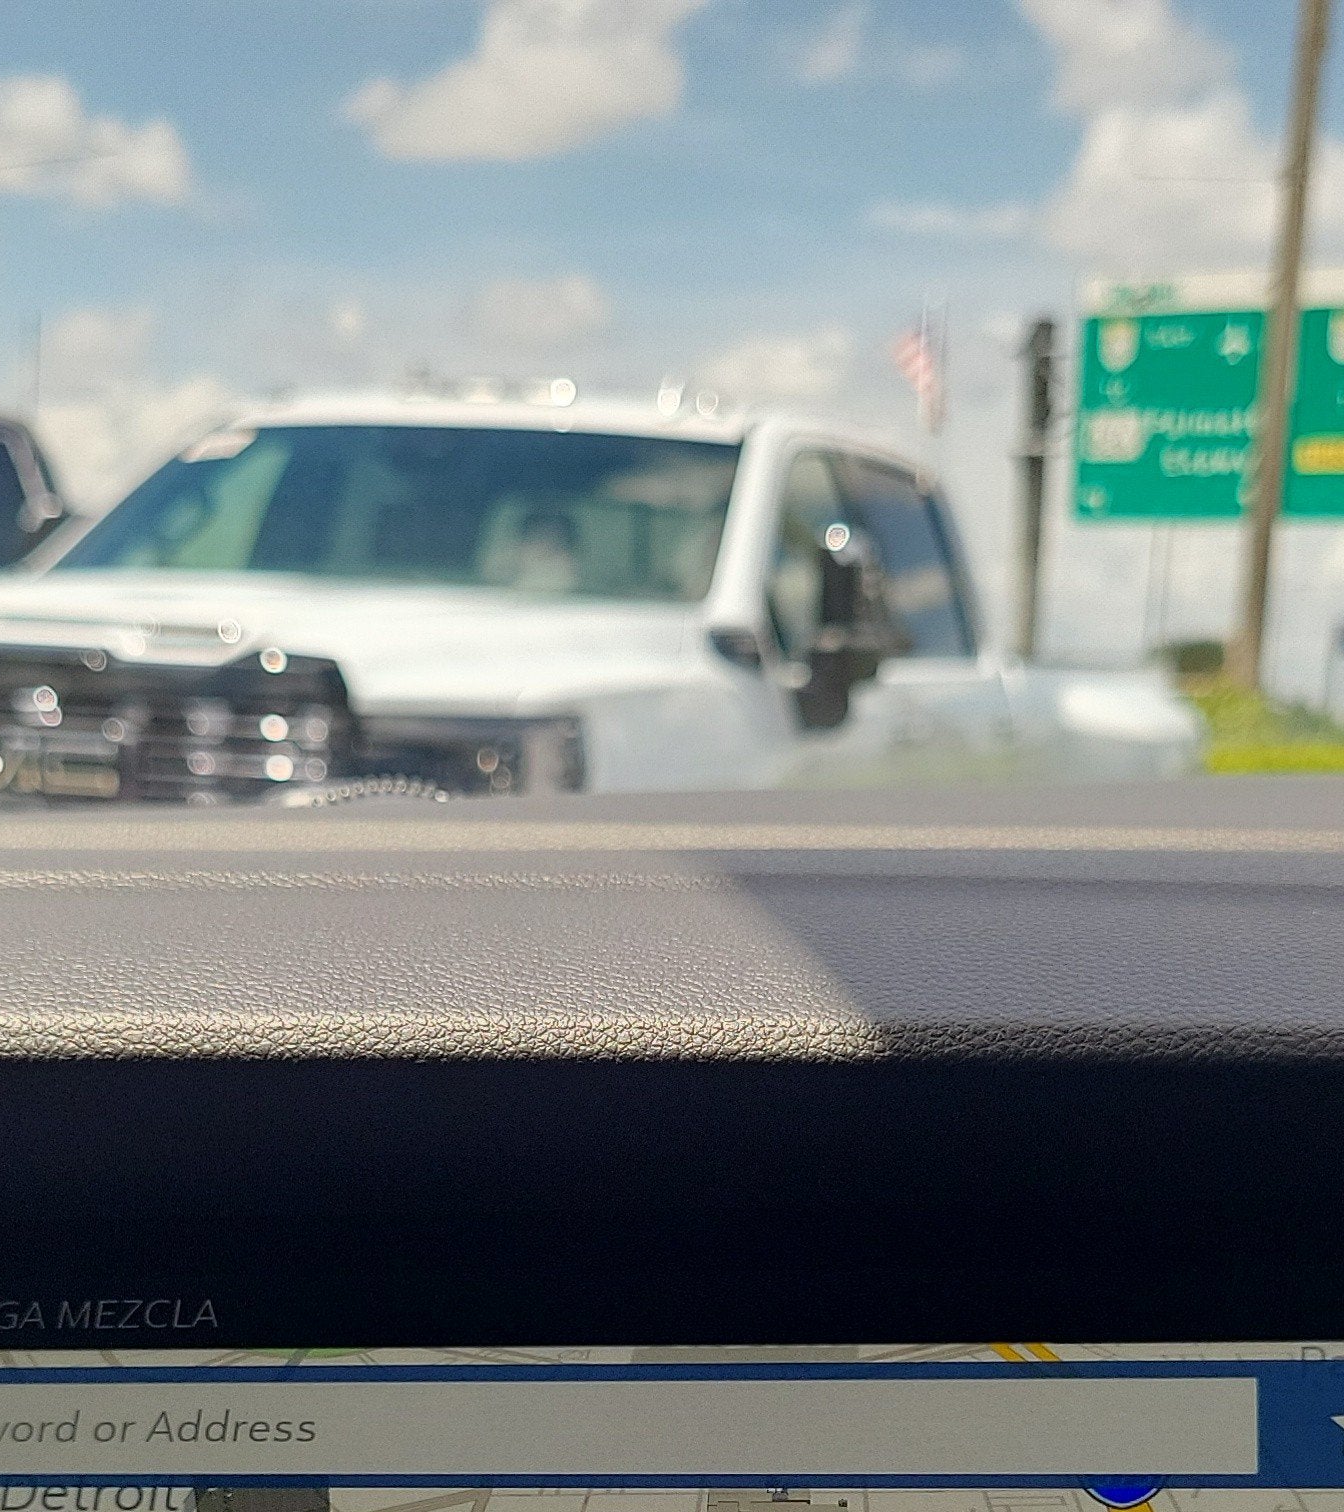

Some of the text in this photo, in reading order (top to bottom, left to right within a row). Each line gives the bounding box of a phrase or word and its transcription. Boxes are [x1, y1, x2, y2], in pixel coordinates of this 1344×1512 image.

[57, 1298, 219, 1331] MEZCLA
[93, 1419, 135, 1443] or
[145, 1409, 317, 1443] Address
